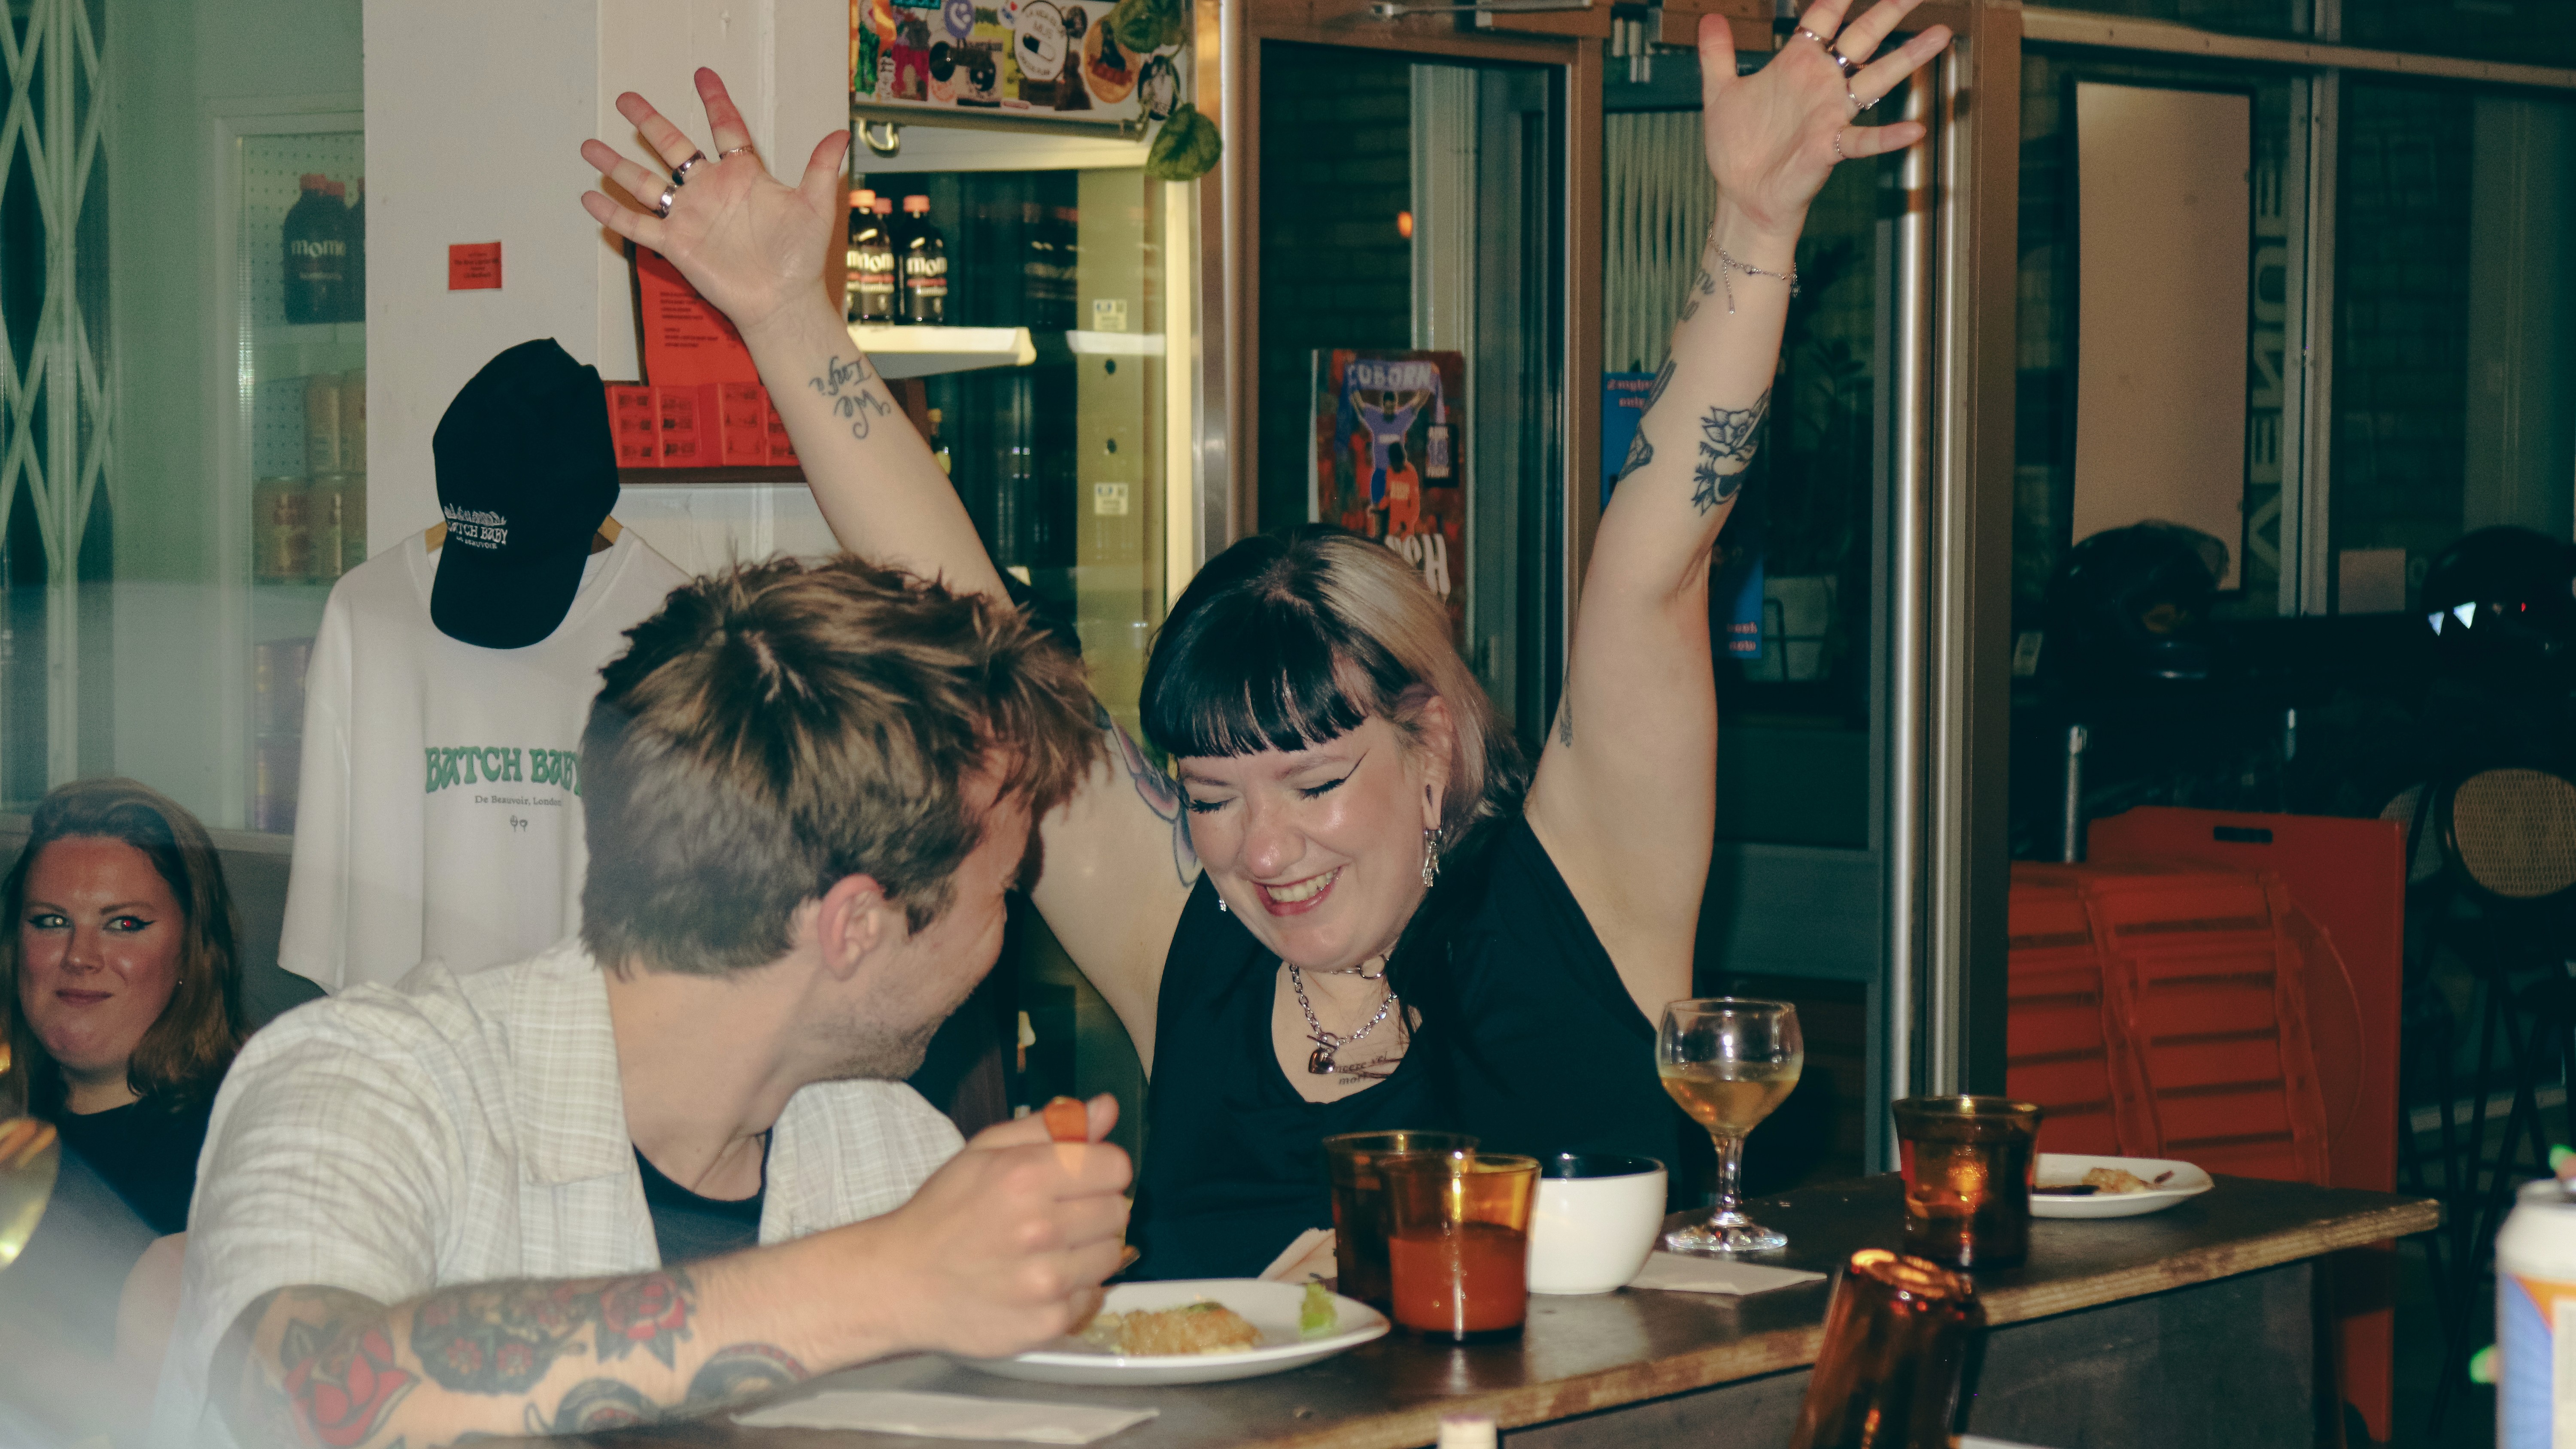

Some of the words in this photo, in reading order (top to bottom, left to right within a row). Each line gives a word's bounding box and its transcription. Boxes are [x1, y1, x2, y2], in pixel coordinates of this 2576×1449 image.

[480, 526, 508, 545] BABY
[465, 539, 498, 549] BEAUVOIR
[425, 746, 523, 794] BATCH
[475, 795, 488, 803] De
[491, 795, 530, 806] Beauvoir,
